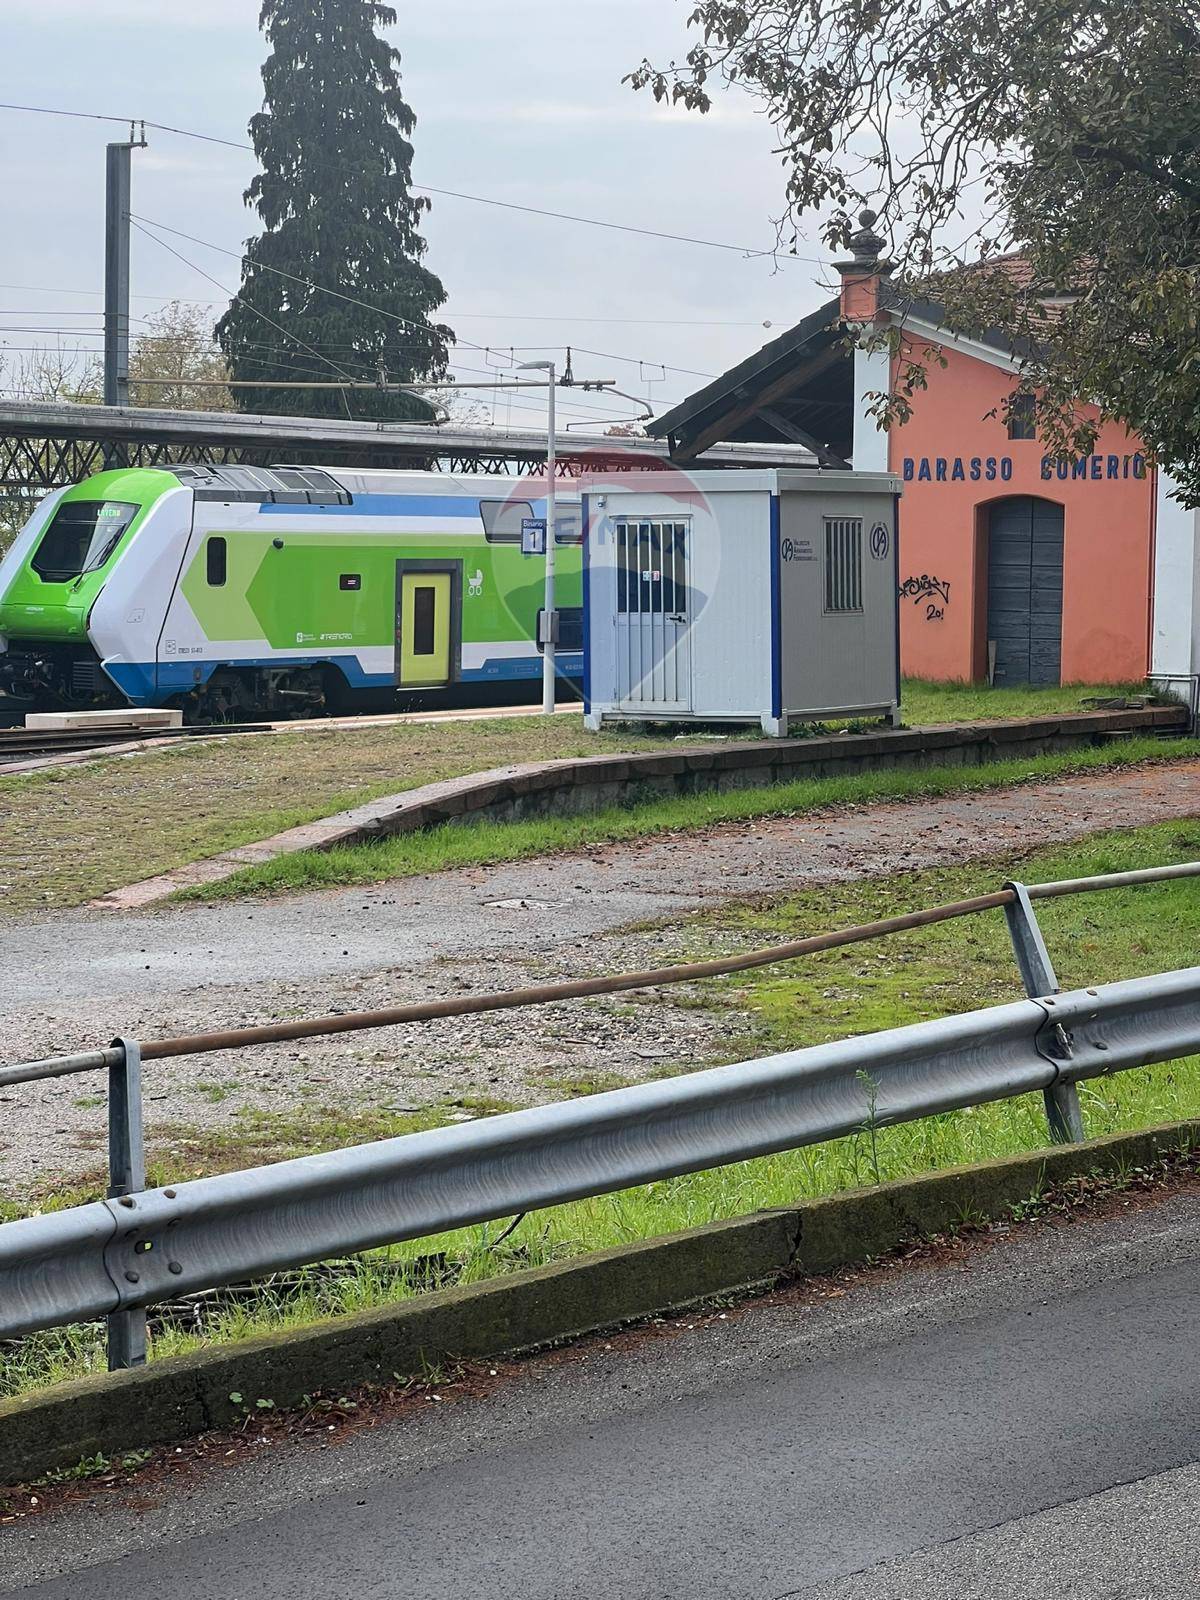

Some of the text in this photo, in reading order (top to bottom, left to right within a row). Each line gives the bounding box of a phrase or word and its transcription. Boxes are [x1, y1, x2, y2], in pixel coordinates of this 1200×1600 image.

[903, 457, 1013, 481] BARASSO
[523, 519, 543, 528] Binario
[529, 531, 537, 549] 1
